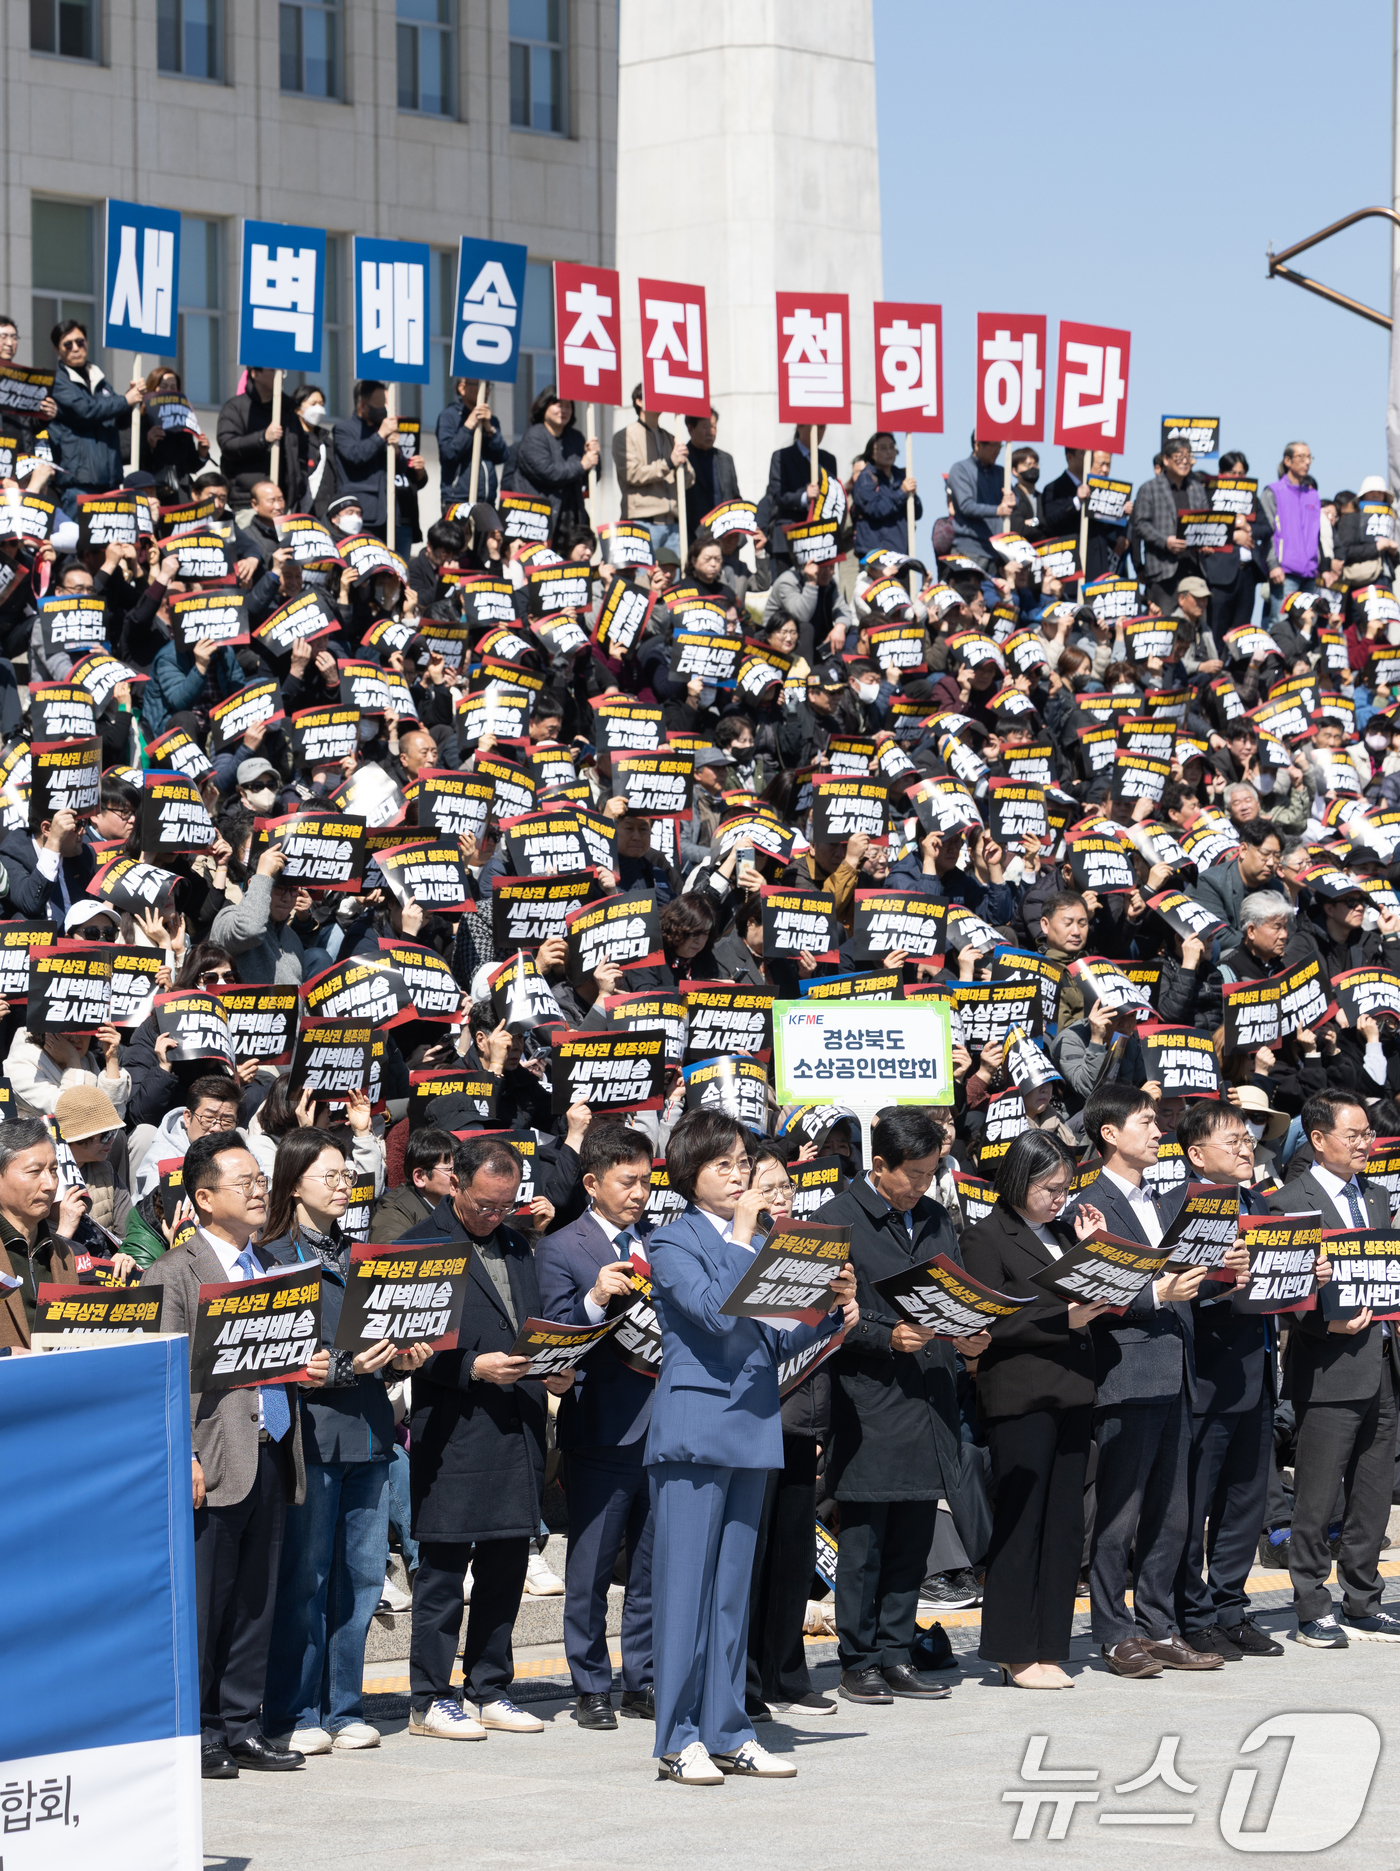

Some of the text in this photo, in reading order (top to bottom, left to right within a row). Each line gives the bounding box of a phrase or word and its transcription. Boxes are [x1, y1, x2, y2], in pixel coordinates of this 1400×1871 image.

[108, 225, 175, 337] 새
[250, 243, 317, 353] 벽
[361, 260, 425, 366] 배
[462, 260, 517, 365] 송
[563, 283, 617, 387] 추
[645, 298, 705, 399] 진
[782, 308, 844, 407] 철
[880, 319, 938, 417] 회
[982, 329, 1043, 426] 하
[1061, 341, 1125, 438] 라
[51, 611, 103, 627] 소상공인
[181, 608, 238, 628] 새벽배송
[51, 626, 106, 644] 다죽는다!
[184, 622, 240, 644] 결사반대
[44, 703, 94, 720] 새벽배송
[46, 718, 96, 735] 결사반대
[301, 725, 357, 744] 새벽배송
[605, 717, 658, 736] 새벽배송
[607, 733, 660, 750] 결사반대
[38, 752, 79, 766] 골목상권
[617, 760, 692, 774] 골목상권 생존위협
[46, 767, 99, 789] 새벽배송
[625, 774, 686, 793] 새벽배송
[48, 786, 99, 810] 결사반대
[152, 786, 188, 800] 골목상권
[424, 779, 494, 800] 골목상권 생존위협
[818, 783, 887, 799] 골목상권 생존위협
[432, 796, 488, 820] 새벽배송
[627, 791, 686, 811] 결사반대
[826, 798, 883, 818] 새벽배송
[999, 801, 1044, 819] 새벽배송
[275, 822, 363, 838] 골목상권 생존위협
[510, 820, 579, 838] 골목상권 생존위협
[829, 816, 883, 837] 결사반대
[285, 837, 353, 859] 새벽배송
[524, 834, 580, 856] 새벽배송
[285, 858, 353, 880] 결사반대
[386, 850, 459, 869] 골목상권 생존위협
[530, 851, 586, 873] 결사반대
[403, 864, 460, 883] 새벽배송
[410, 882, 465, 902] 결사반대
[499, 882, 590, 899] 골목상권 생존위협
[766, 895, 832, 914] 골목상권 생존위협
[860, 899, 946, 918] 골목상권 생존위협
[571, 899, 652, 934] 골목상권 생존위협
[774, 911, 829, 934] 새벽배송
[867, 914, 937, 937] 새벽배송
[3, 931, 53, 946] 생존위협
[578, 918, 646, 952] 새벽배송
[775, 930, 830, 953] 결사반대
[868, 932, 937, 957] 결사반대
[113, 955, 162, 973] 생존위협
[581, 937, 650, 972] 결사반대
[37, 959, 85, 974] 골목상권
[1127, 970, 1160, 982] 생존위협
[1288, 960, 1319, 990] 생존위협
[307, 957, 391, 1007] 골목상권 생존위협
[808, 974, 899, 999] 대형마트 규제완화
[992, 985, 1037, 1000] 규제완화
[164, 999, 213, 1013] 골목상권
[257, 996, 295, 1010] 생존위협
[686, 990, 775, 1009] 골목상권 생존위협
[1228, 987, 1280, 1006] 골목상권 생존위협
[613, 1003, 689, 1018] 골목상권 생존위협
[690, 1009, 765, 1032] 새벽배송
[788, 1014, 823, 1025] KFME
[960, 1001, 1030, 1022] 소상공인
[1235, 1002, 1278, 1026] 새벽배송
[303, 1026, 371, 1044] 골목상권 생존위협
[690, 1030, 765, 1052] 결사반대
[823, 1029, 905, 1050] 경상북도
[1147, 1035, 1214, 1052] 골목상권 생존위협
[1237, 1021, 1278, 1045] 결사반대
[305, 1045, 364, 1068] 새벽배송
[559, 1041, 661, 1057] 골목상권 생존위협
[567, 1058, 651, 1081] 새벽배송
[793, 1058, 937, 1079] 소상공인연합회
[1159, 1050, 1212, 1072] 새벽배송
[417, 1082, 493, 1096] 골목상권 생존위협
[1164, 1068, 1217, 1091] 결사반대
[569, 1080, 653, 1104] 결사반대
[802, 1168, 838, 1187] 생존위협
[1186, 1198, 1218, 1214] 골목상권
[1179, 1219, 1238, 1242] 새벽배송
[1245, 1228, 1322, 1246] 골목상권 생존위협
[770, 1233, 822, 1255] 골목상권
[1085, 1241, 1138, 1265] 골목상권
[77, 1257, 92, 1270] 사수
[357, 1257, 467, 1278] 골목상권 생존위협
[759, 1257, 841, 1285] 새벽배송
[1251, 1249, 1316, 1275] 새벽배송
[1332, 1259, 1400, 1282] 새벽배송
[1073, 1258, 1152, 1290] 새벽배송
[363, 1281, 453, 1310] 새벽배송
[743, 1282, 827, 1308] 결사반대
[926, 1267, 982, 1305] 골목상권
[1055, 1272, 1139, 1307] 결사반대
[1249, 1274, 1312, 1301] 결사반대
[207, 1282, 320, 1316] 골목상권 생존위협
[912, 1285, 997, 1329] 새벽배송
[46, 1302, 159, 1322] 골목상권 생존위협
[213, 1309, 316, 1346] 새벽배송
[359, 1310, 451, 1339] 결사반대
[527, 1332, 593, 1346] 골목상권
[212, 1338, 317, 1375] 결사반대
[0, 1775, 80, 1834] 합회,
